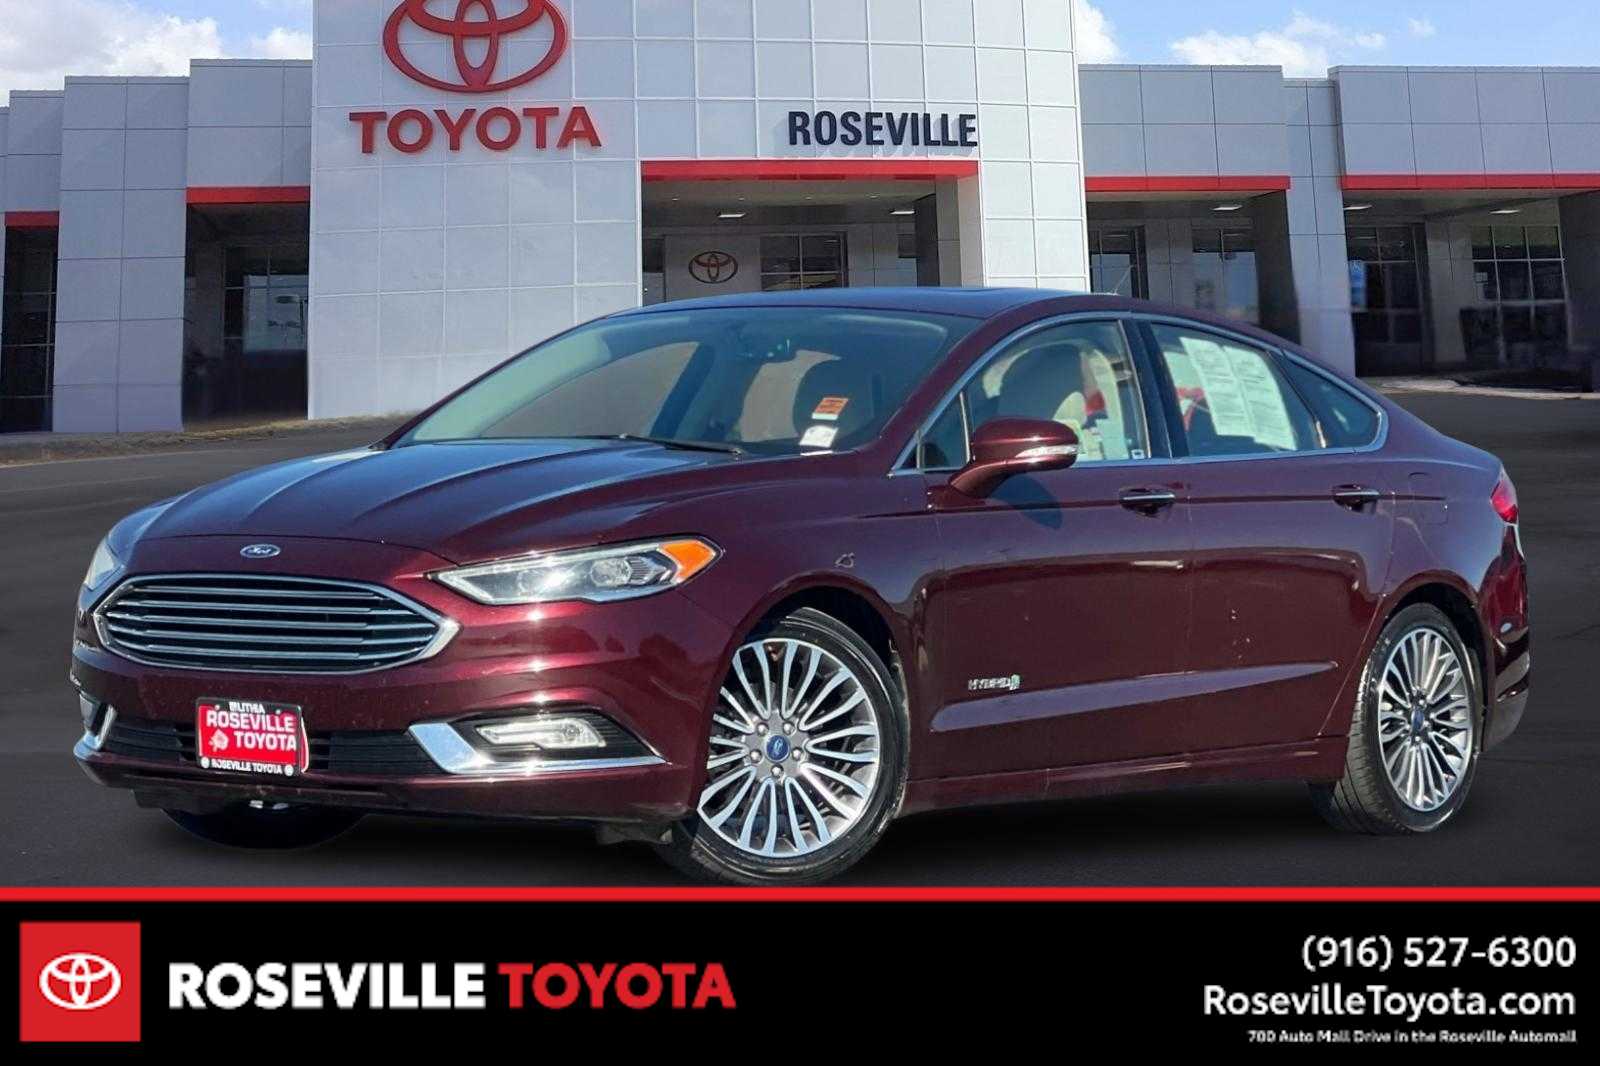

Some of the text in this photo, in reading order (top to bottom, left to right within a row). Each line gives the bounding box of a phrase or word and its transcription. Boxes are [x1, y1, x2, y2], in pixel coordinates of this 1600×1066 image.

[349, 106, 602, 154] TOYOTA
[788, 110, 978, 147] ROSEVILLE
[206, 710, 295, 733] ROSEVILLE
[234, 731, 297, 752] TOYOTA
[211, 759, 283, 775] ROSEVILLE TOYOTA
